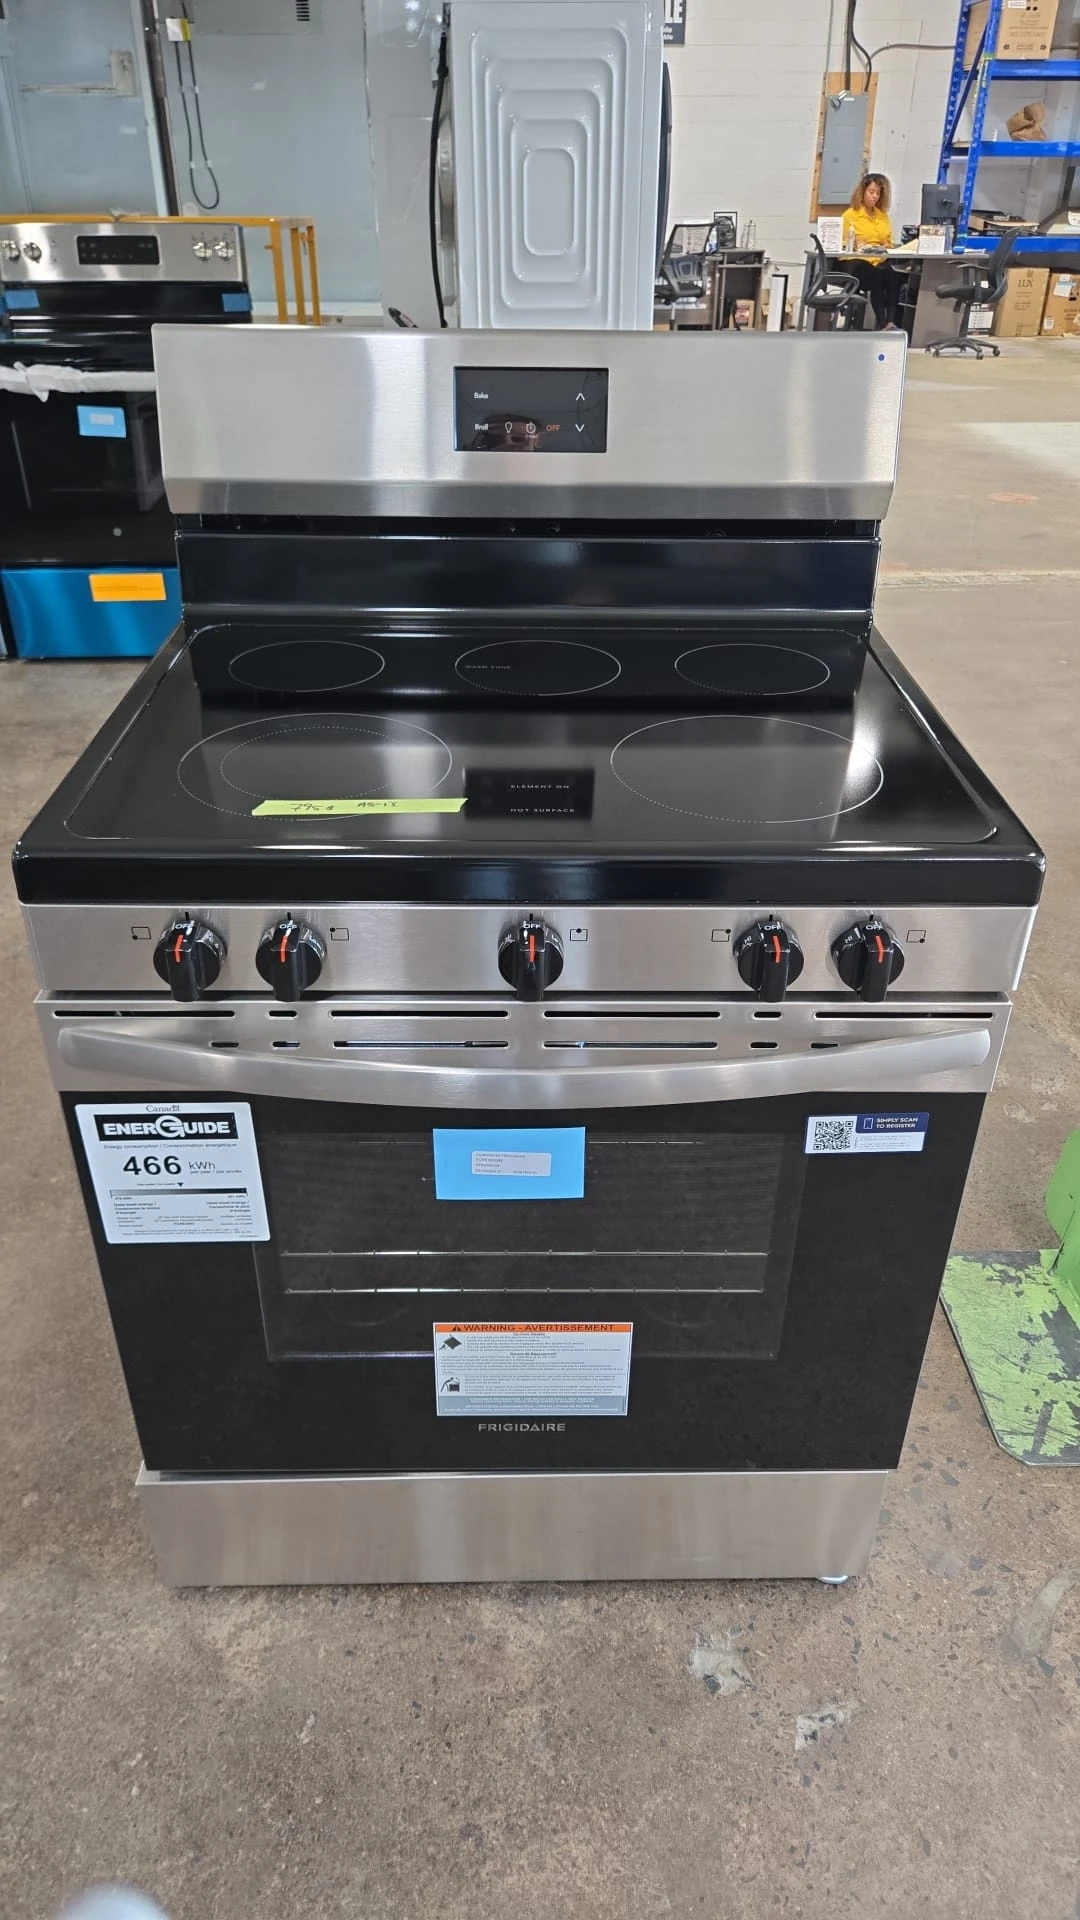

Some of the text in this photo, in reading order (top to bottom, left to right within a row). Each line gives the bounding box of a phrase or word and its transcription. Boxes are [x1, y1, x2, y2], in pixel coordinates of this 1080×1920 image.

[545, 424, 560, 432] OFF
[103, 1115, 231, 1138] ENERGUIDE
[123, 1155, 182, 1175] 466
[189, 1161, 216, 1170] kWh
[524, 1324, 614, 1332] AVERTISSEMENT
[478, 1423, 566, 1432] FRIGIDAIRE
